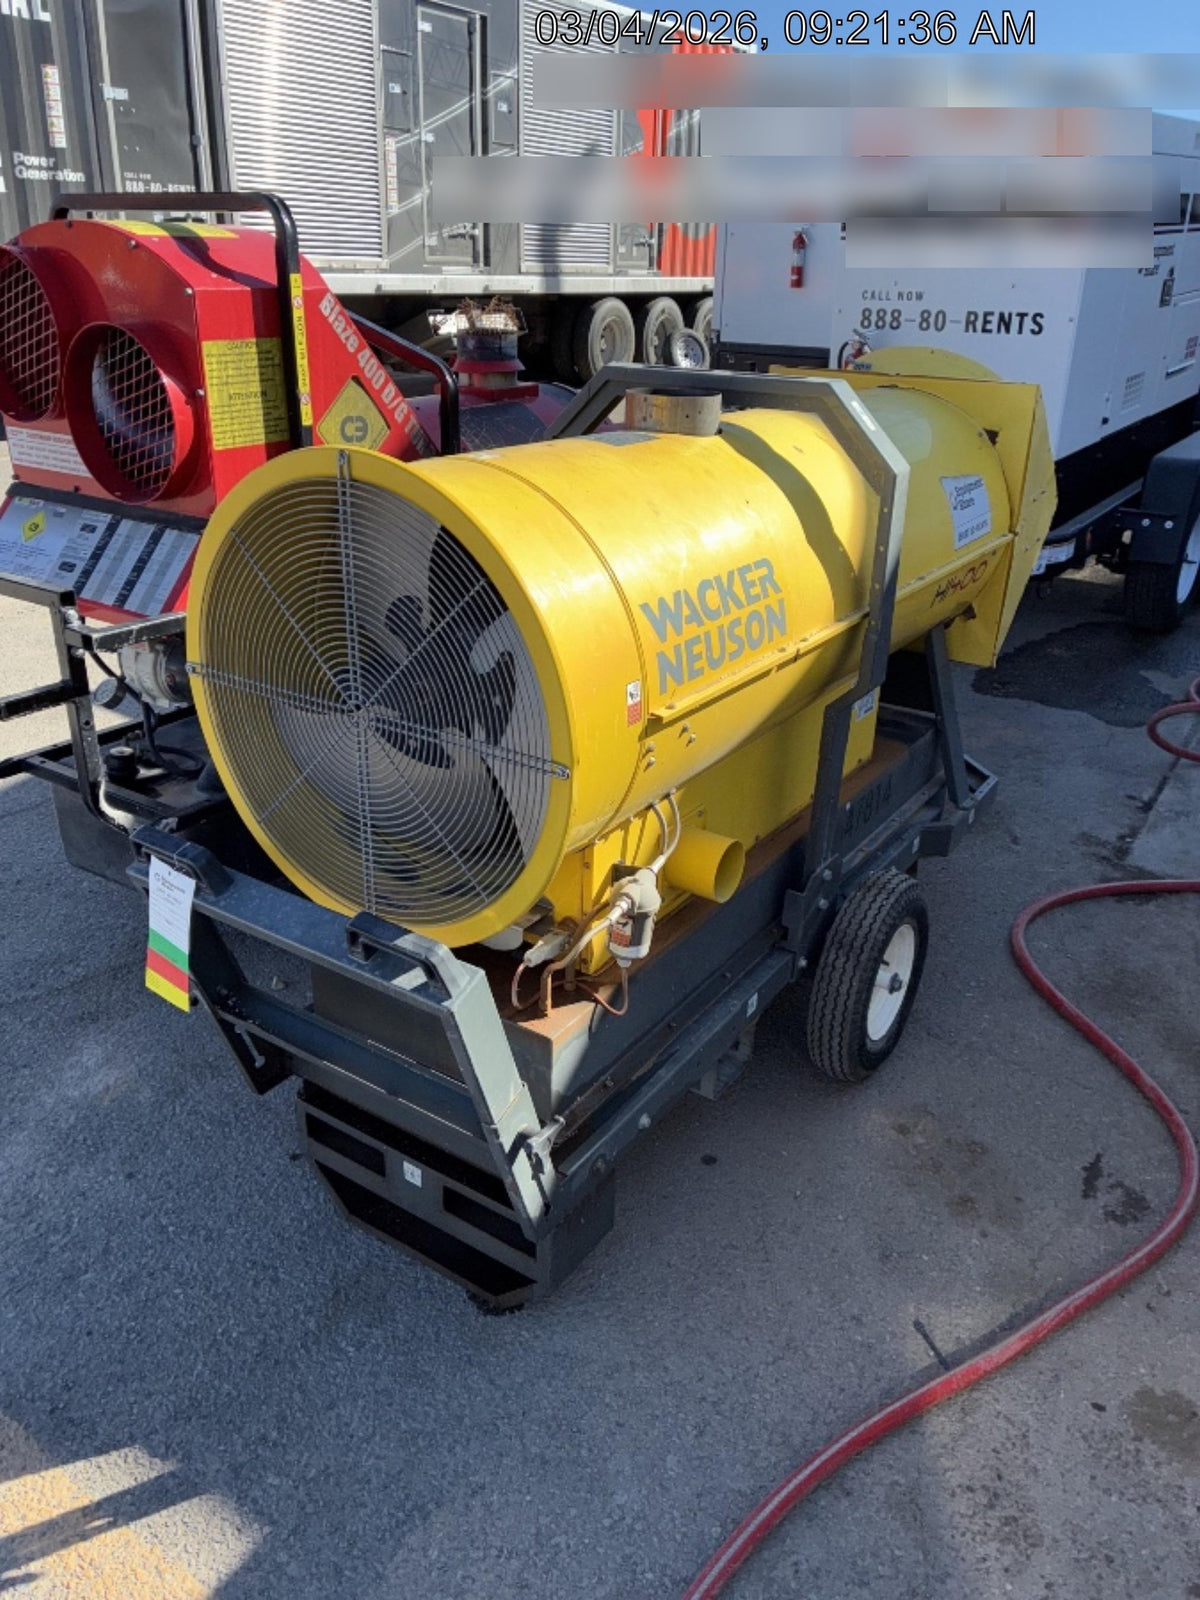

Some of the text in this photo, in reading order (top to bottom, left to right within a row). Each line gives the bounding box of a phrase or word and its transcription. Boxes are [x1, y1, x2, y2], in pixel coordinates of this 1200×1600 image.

[13, 151, 55, 168] Power
[15, 165, 86, 183] Generation
[862, 290, 925, 302] CALL NOW
[860, 307, 1045, 336] 888-80-RENTS
[318, 291, 359, 353] Blaze
[357, 347, 386, 390] 400
[638, 558, 783, 644] WACKER
[656, 597, 788, 696] NEUSON
